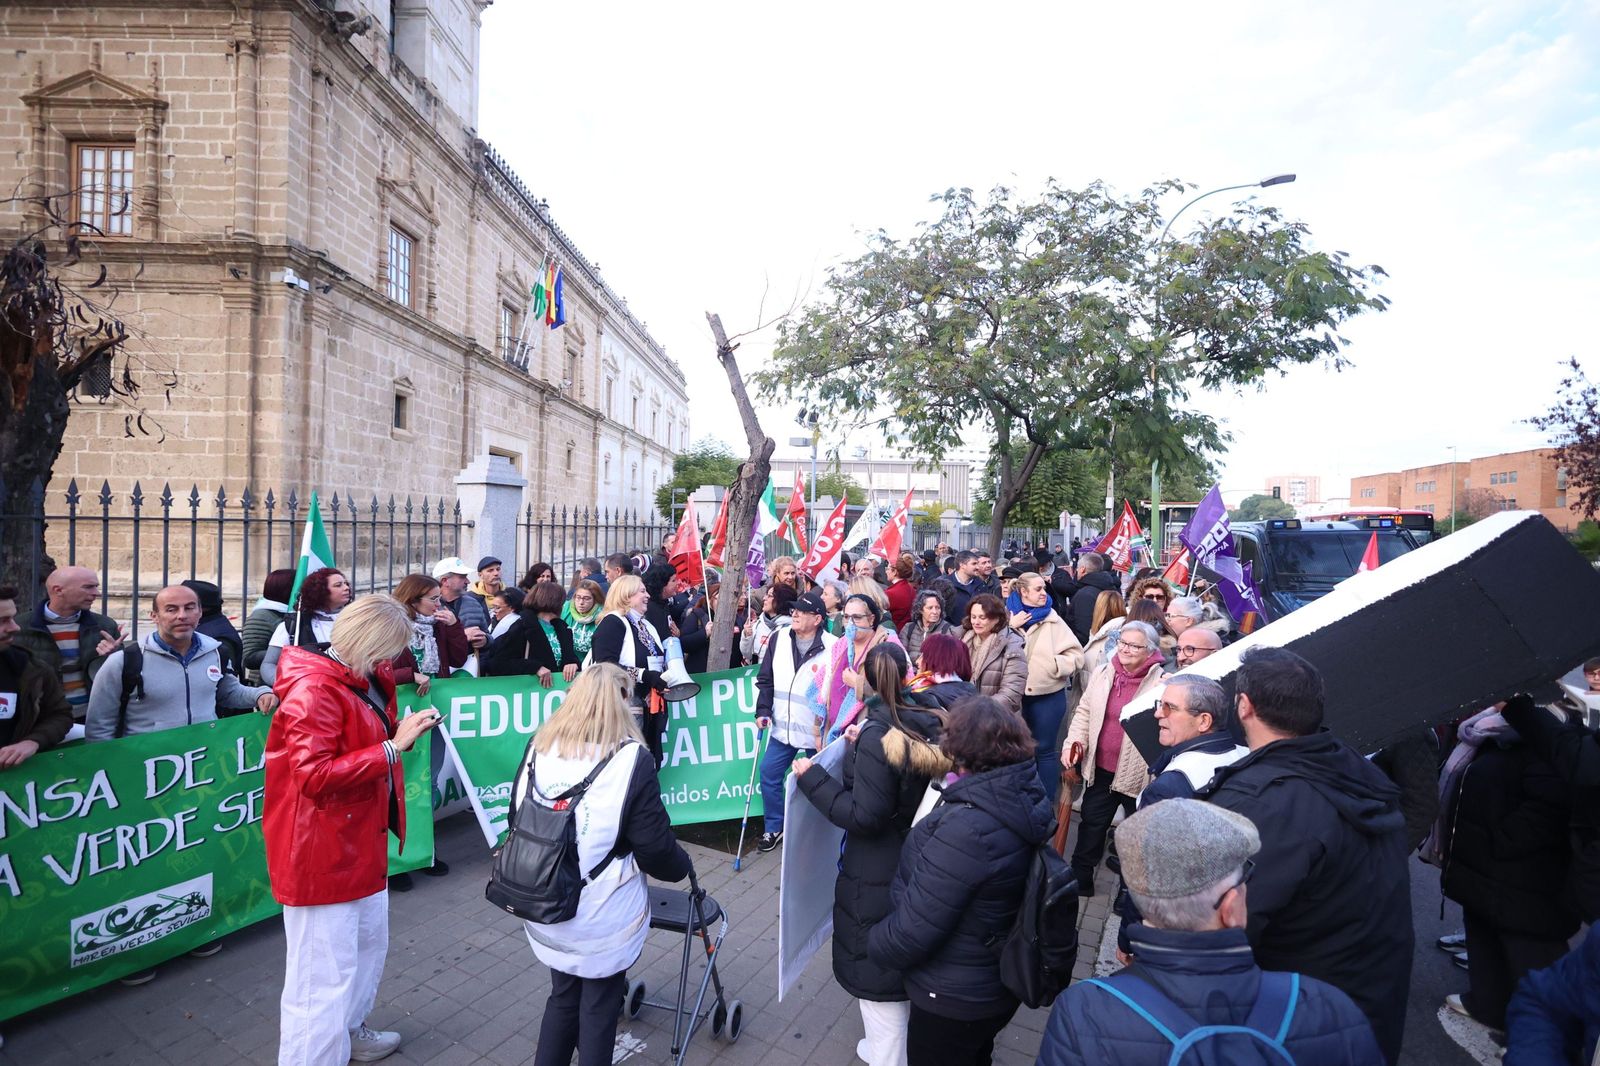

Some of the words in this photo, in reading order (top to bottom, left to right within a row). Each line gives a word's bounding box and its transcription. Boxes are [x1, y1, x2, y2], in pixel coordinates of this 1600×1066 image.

[143, 746, 215, 800] DE
[42, 806, 206, 886] VERDE
[72, 944, 117, 967] MAREA
[119, 928, 163, 951] VERDE
[165, 907, 210, 934] SEVILLA
